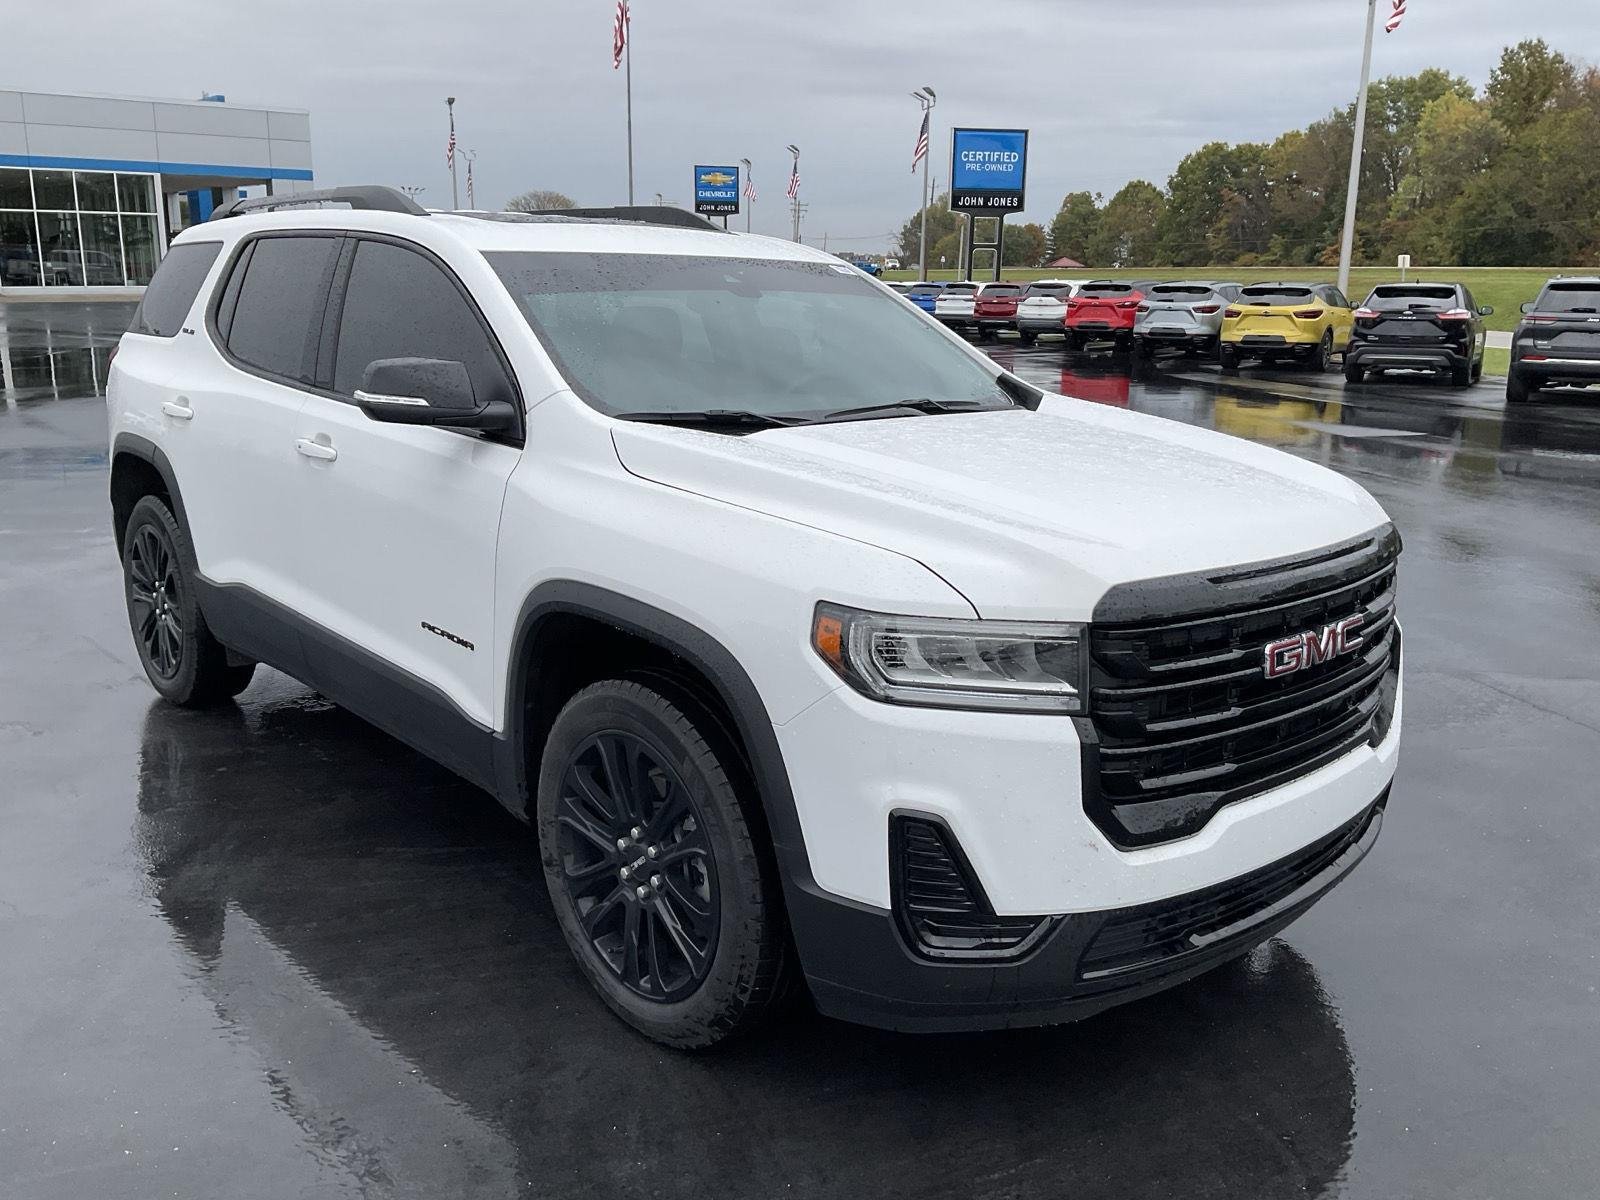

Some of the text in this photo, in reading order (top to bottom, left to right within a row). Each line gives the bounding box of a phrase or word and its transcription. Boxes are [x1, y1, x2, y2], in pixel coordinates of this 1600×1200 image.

[961, 151, 1019, 162] CERTIFIED
[965, 163, 1014, 172] PRE-OWNED
[698, 190, 736, 198] CHEVROLET
[958, 196, 1018, 207] JOHN JONES
[420, 621, 475, 651] ACADIA
[1264, 613, 1364, 679] GMC
